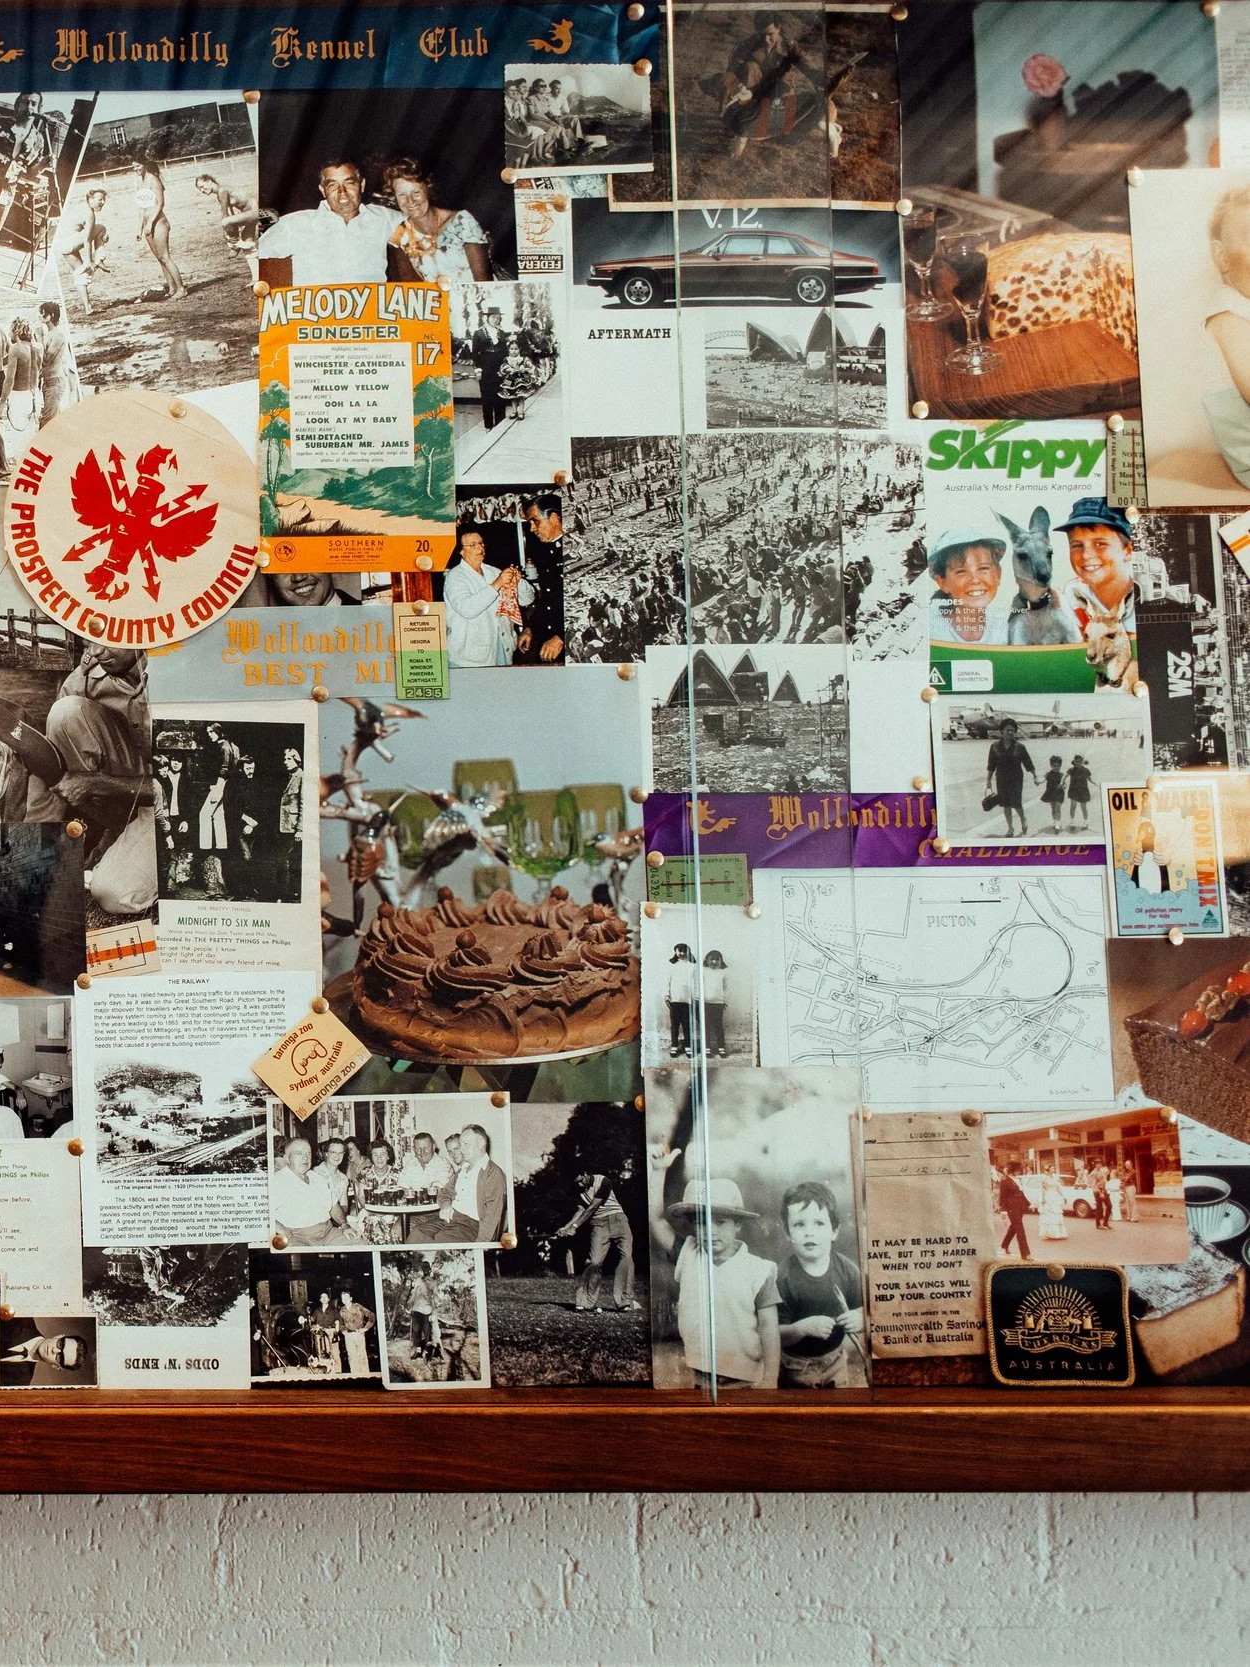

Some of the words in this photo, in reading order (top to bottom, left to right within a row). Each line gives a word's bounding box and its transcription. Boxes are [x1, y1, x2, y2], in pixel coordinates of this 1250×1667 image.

[51, 28, 229, 72] Wollondilly
[270, 26, 376, 69] Kennel
[418, 26, 489, 64] Club
[260, 285, 371, 332] MELODY
[377, 283, 442, 322] LANE
[298, 325, 400, 341] SONGSTER
[587, 328, 672, 339] AFTERMATH
[416, 341, 442, 365] 17
[294, 361, 349, 369] WINCHESTER
[354, 360, 407, 368] CATHEDRAL
[312, 384, 349, 392] MELLOW
[324, 400, 344, 408] OOH
[349, 400, 360, 408] LA
[306, 416, 330, 424] LOOK
[336, 416, 348, 424] AT
[353, 416, 366, 424] MY
[372, 415, 398, 424] BABY
[305, 440, 353, 449] SUBURBAN
[359, 440, 375, 448] MR.
[381, 440, 410, 448] JAMES
[925, 418, 1108, 479] Skippy
[14, 446, 54, 497] THE
[944, 483, 989, 492] Australia's
[991, 483, 1012, 491] Most
[1014, 483, 1048, 491] Famous
[1050, 483, 1093, 492] Kangaroo
[328, 539, 385, 547] SOUTHERN
[415, 539, 430, 553] 20
[11, 502, 82, 621] PROSPECT
[181, 543, 259, 630] COUNCIL
[1166, 650, 1193, 698] 2SM
[405, 688, 442, 698] 2435
[177, 917, 217, 927] MIDNIGHT
[221, 917, 233, 927] TO
[236, 917, 249, 927] SIX
[252, 917, 271, 928] MAN
[273, 1031, 299, 1060] taronga
[299, 1022, 314, 1035] zoo
[289, 1074, 320, 1092] sydney
[320, 1040, 343, 1075] australia
[308, 1073, 342, 1106] taronga
[340, 1061, 356, 1077] zoo
[871, 1239, 880, 1247] IT
[884, 1238, 906, 1247] MAY
[911, 1238, 921, 1246] BE
[925, 1237, 952, 1245] HARD
[956, 1236, 968, 1244] TO
[867, 1251, 891, 1260] SAVE,
[897, 1250, 914, 1259] BUT
[920, 1249, 936, 1258] IT'S
[942, 1248, 977, 1257] HARDER
[882, 1262, 909, 1271] WHEN
[913, 1261, 932, 1269] YOU
[936, 1260, 963, 1269] DON'T
[875, 1282, 901, 1291] YOUR
[905, 1280, 945, 1289] SAVINGS
[949, 1279, 971, 1288] WILL
[874, 1293, 896, 1302] HELP
[899, 1292, 925, 1301] YOUR
[929, 1290, 972, 1300] COUNTRY
[882, 1335, 910, 1345] Bank
[912, 1334, 923, 1344] of
[926, 1331, 974, 1344] Australia
[124, 1358, 160, 1370] ENDS
[185, 1358, 220, 1370] ODDS
[1009, 1360, 1115, 1370] AUSTRALIA
